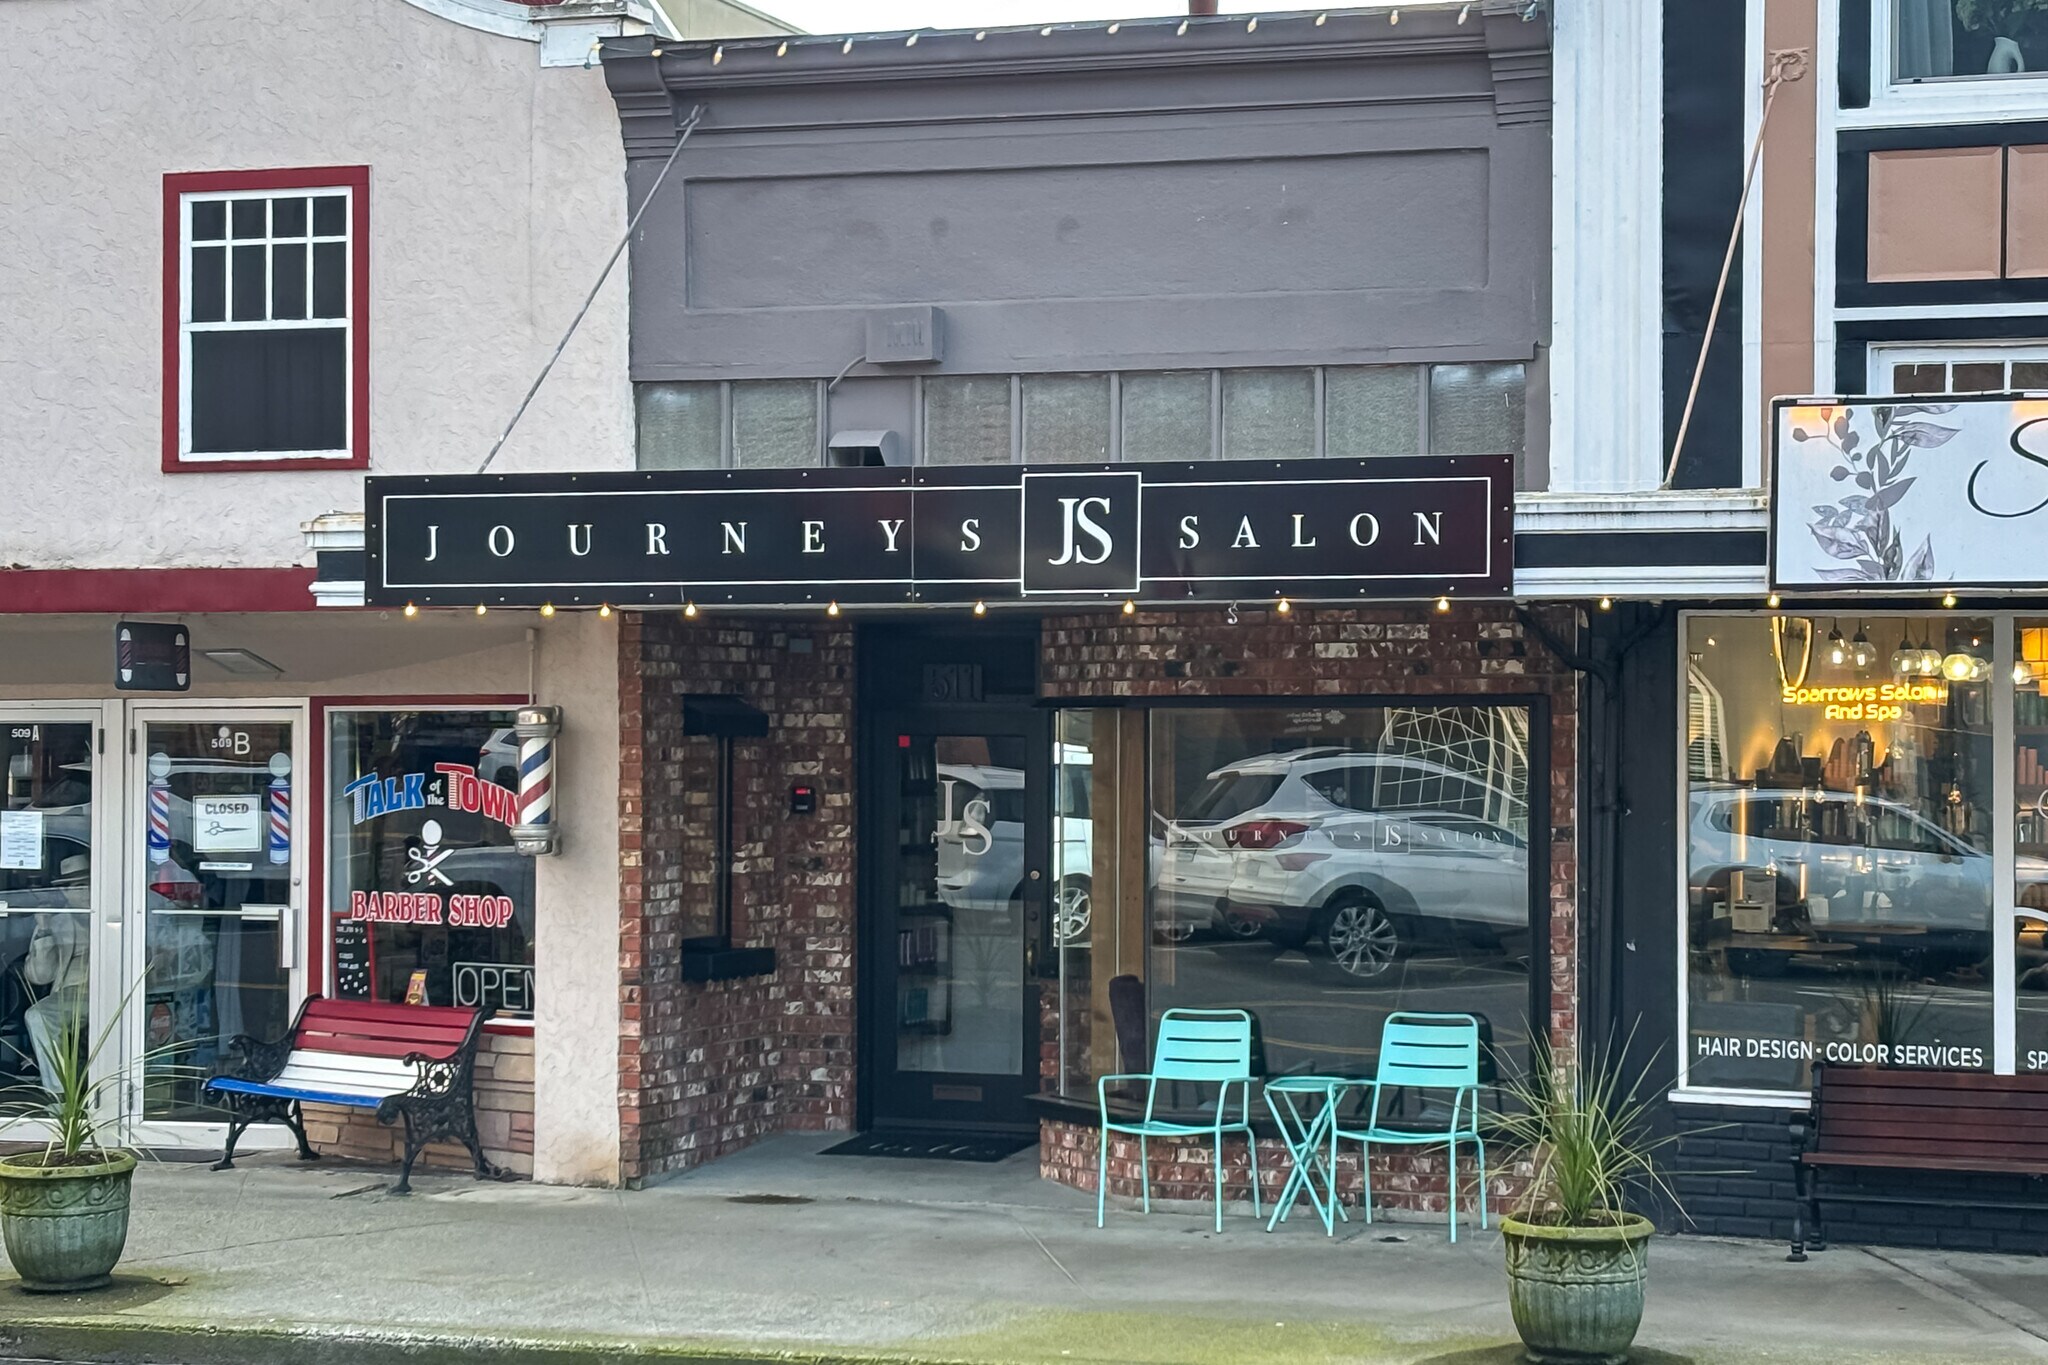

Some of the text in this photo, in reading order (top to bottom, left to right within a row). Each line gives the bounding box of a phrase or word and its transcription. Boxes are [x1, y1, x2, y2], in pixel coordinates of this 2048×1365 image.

[424, 497, 1444, 565] JOURNEYS JS SALON
[1783, 682, 1935, 704] Sparrows Salon
[1825, 703, 1902, 721] And Spa
[430, 779, 442, 794] of
[205, 803, 250, 815] CLOSED
[343, 772, 426, 825] TALK
[427, 794, 445, 806] the
[931, 780, 993, 855] JS
[1182, 825, 1502, 846] JOURNEYS JS SALON
[351, 890, 514, 928] BARBER SHOP
[1698, 1037, 1984, 1068] HAIR DESIGN COLOR SERVICES
